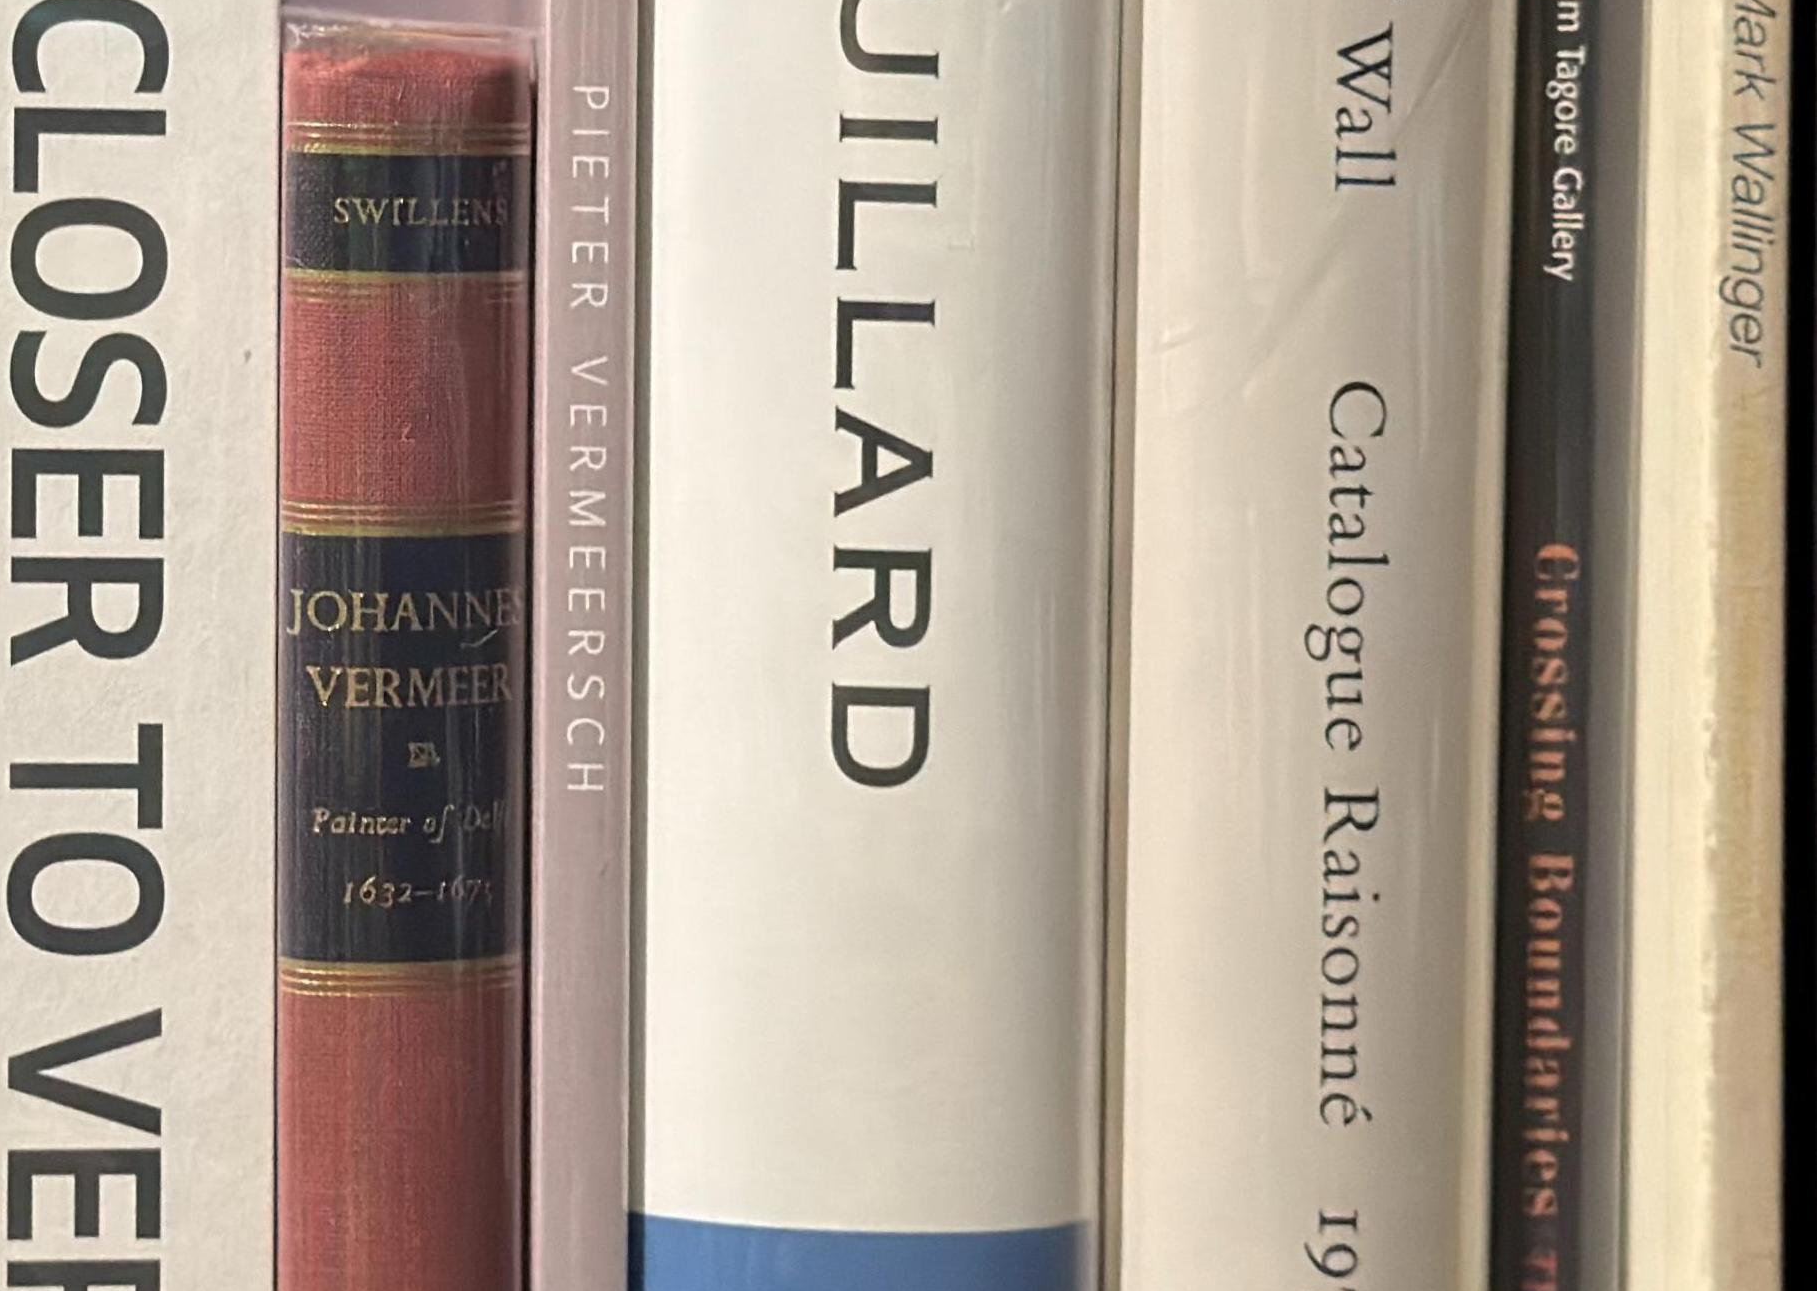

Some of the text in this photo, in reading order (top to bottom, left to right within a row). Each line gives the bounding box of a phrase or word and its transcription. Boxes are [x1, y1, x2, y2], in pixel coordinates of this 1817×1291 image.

[1333, 21, 1398, 192] Wall
[1545, 44, 1587, 154] Tagore
[1541, 163, 1586, 283] Gallery
[1717, 122, 1777, 368] Wallinger
[567, 85, 610, 791] PIETER VERMEERSCH
[306, 664, 512, 708] VERMEER
[1305, 380, 1389, 754] Catalogue
[1525, 543, 1581, 822] Crossing
[6, 722, 165, 956] TO
[313, 804, 455, 843] Painter of
[1318, 785, 1381, 1128] Raisonné
[1521, 850, 1575, 1219] Boundaries
